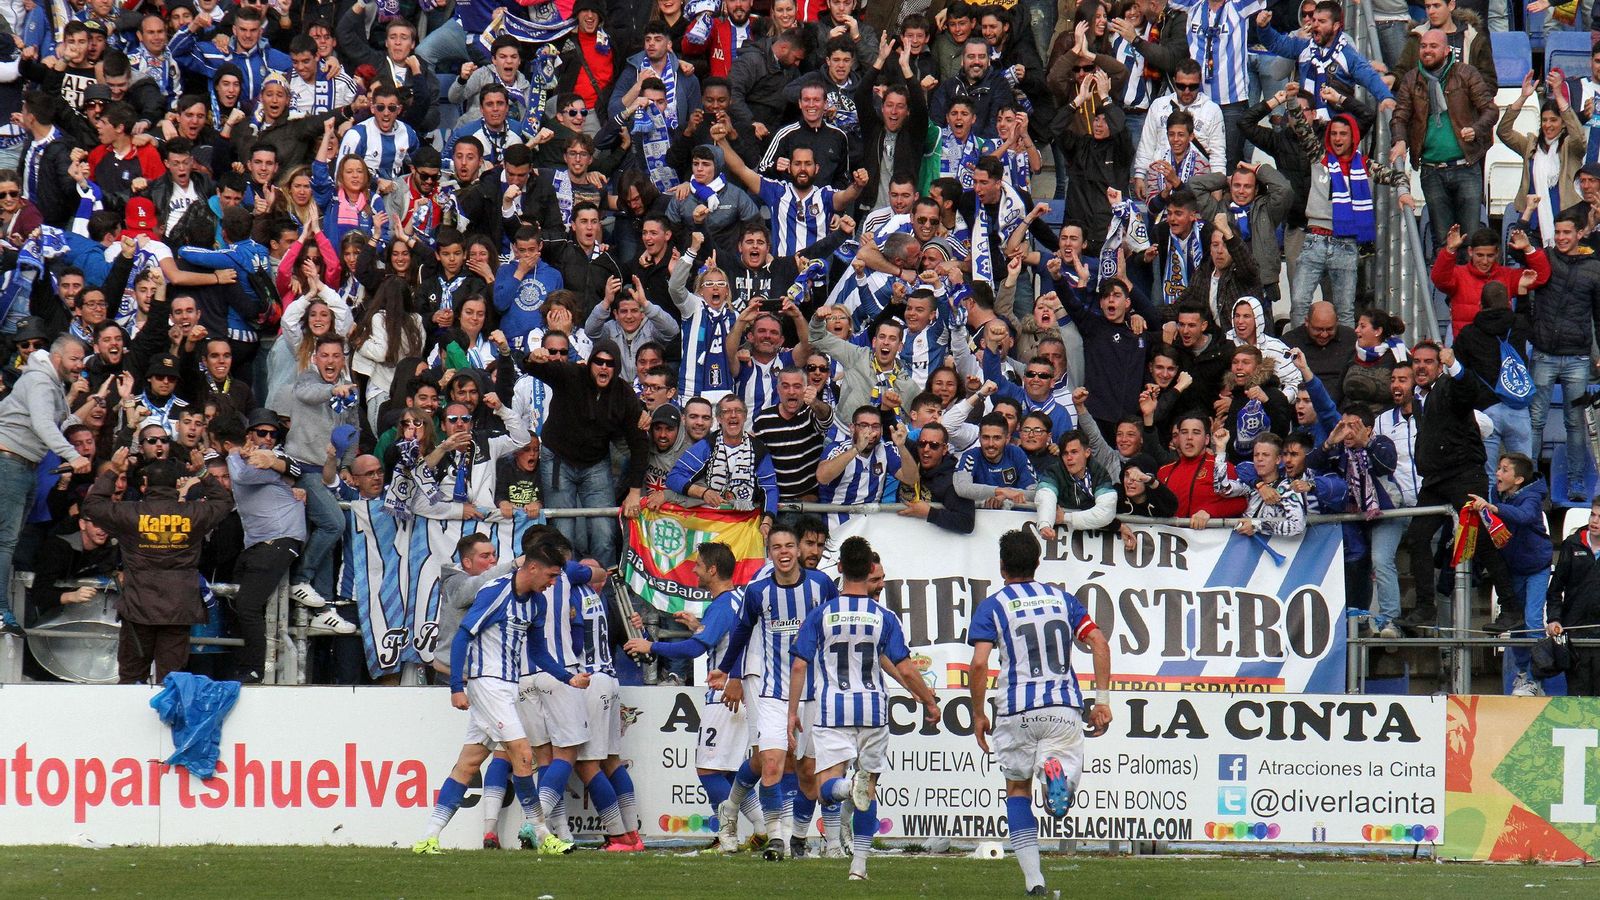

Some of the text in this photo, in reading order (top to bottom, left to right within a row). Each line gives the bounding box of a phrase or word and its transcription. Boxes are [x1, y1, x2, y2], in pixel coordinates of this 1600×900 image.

[1015, 619, 1072, 678] 10
[829, 641, 876, 691] 11
[1125, 698, 1209, 739] LA
[1224, 699, 1422, 743] CINTA
[662, 747, 688, 768] SU
[902, 751, 976, 771] HUELVA
[1081, 754, 1111, 774] Las
[1117, 754, 1199, 780] Palomas)
[1258, 760, 1362, 777] Atracciones
[1368, 761, 1384, 777] la
[1389, 761, 1437, 778] Cinta
[925, 787, 994, 807] PRECIO
[1096, 790, 1119, 810] EN
[1124, 790, 1187, 811] BONOS
[1250, 789, 1436, 818] @diverlacinta
